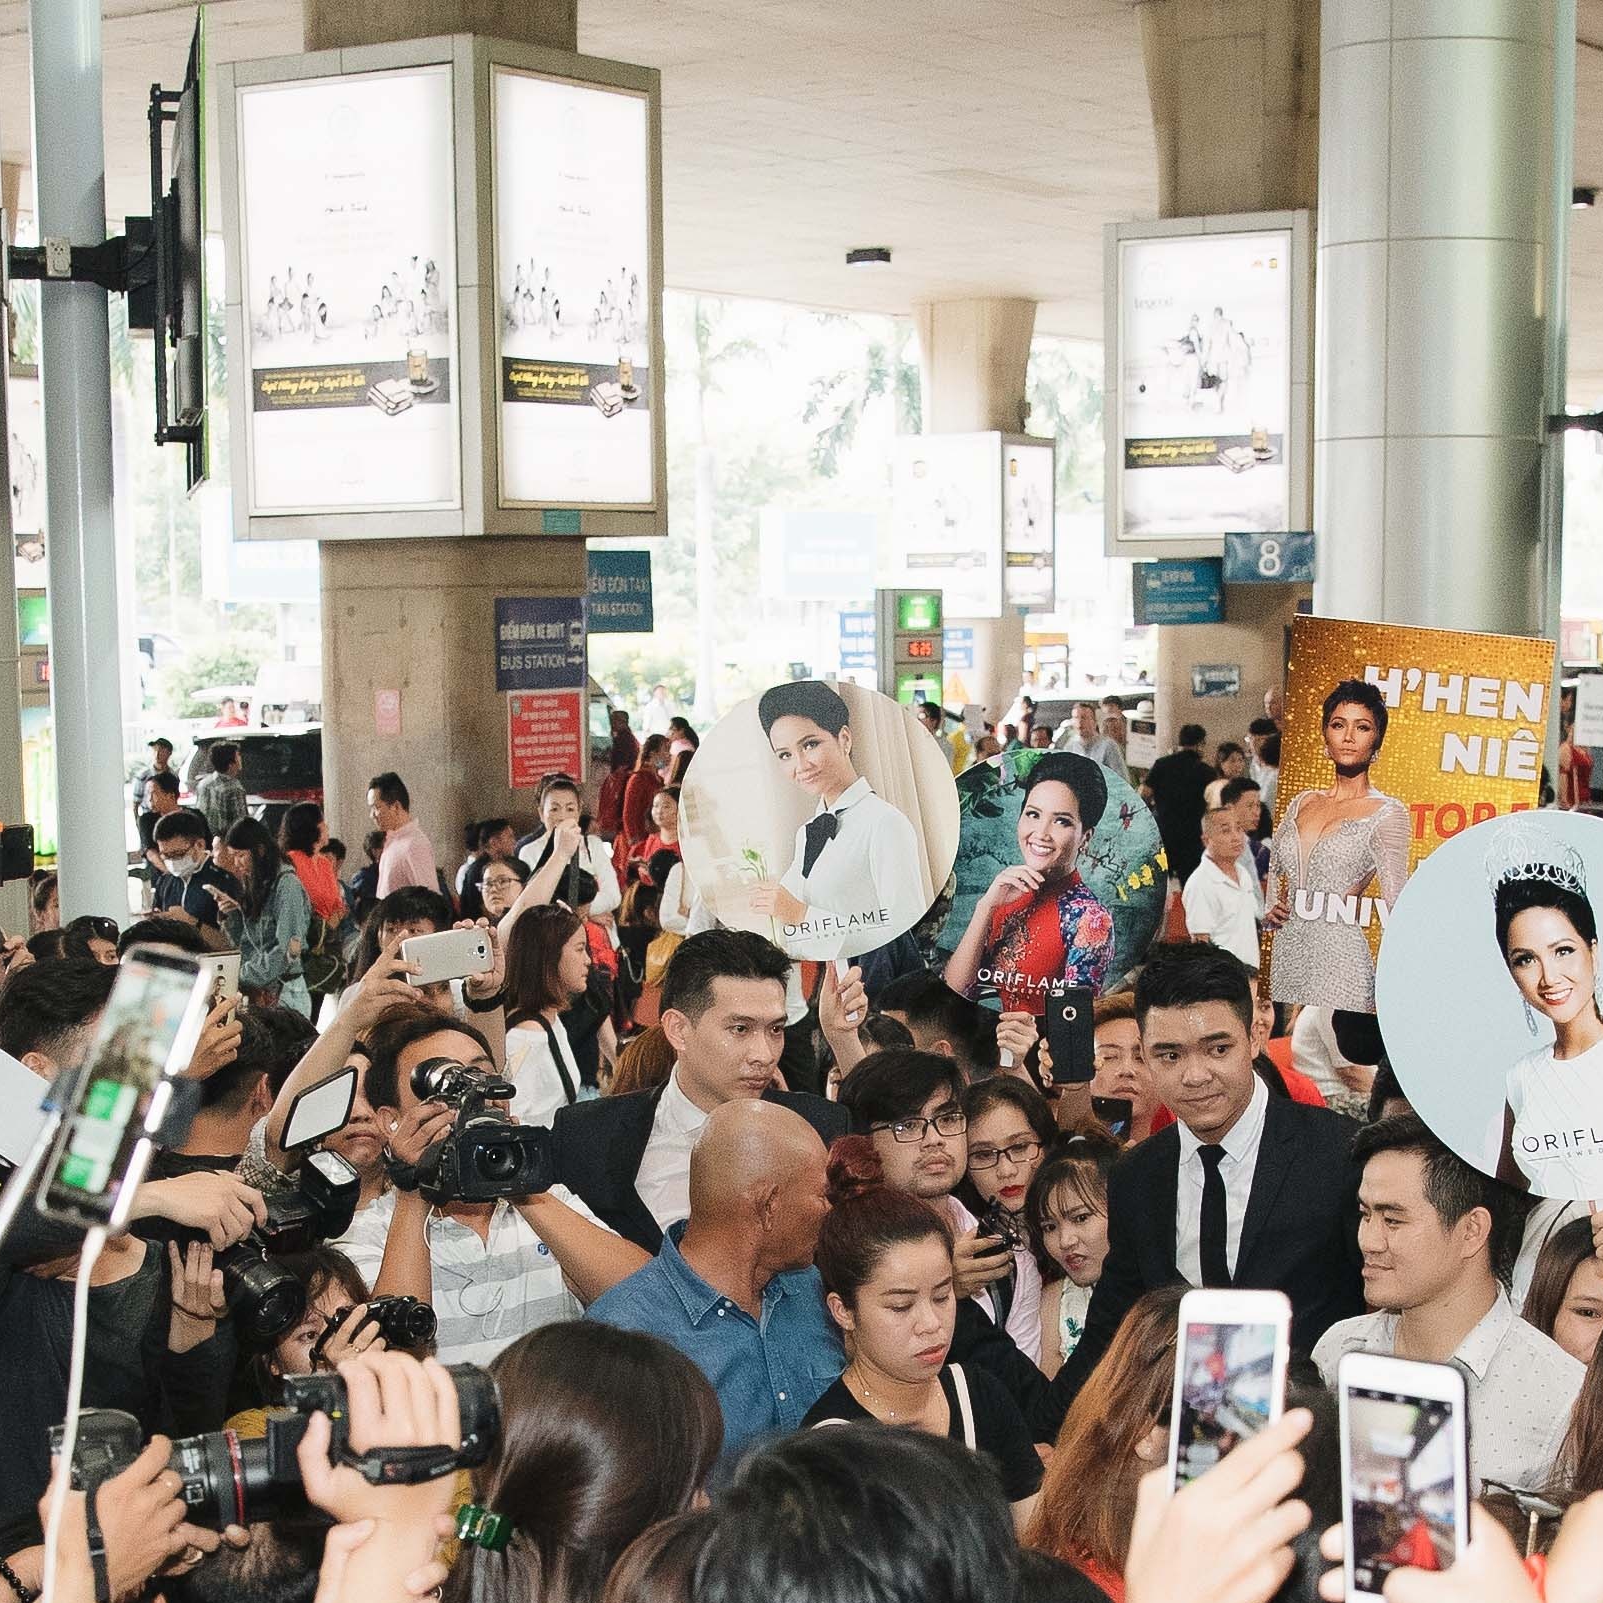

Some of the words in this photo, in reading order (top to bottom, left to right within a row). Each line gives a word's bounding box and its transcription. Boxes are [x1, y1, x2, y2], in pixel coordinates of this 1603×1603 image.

[1258, 539, 1282, 577] 8
[500, 655, 523, 671] BUS
[524, 654, 566, 670] STATION
[1363, 663, 1545, 725] H'HEN
[1440, 728, 1540, 782] NIÊ
[782, 907, 891, 938] ORIFLAME
[976, 967, 1079, 990] ORIFLAME
